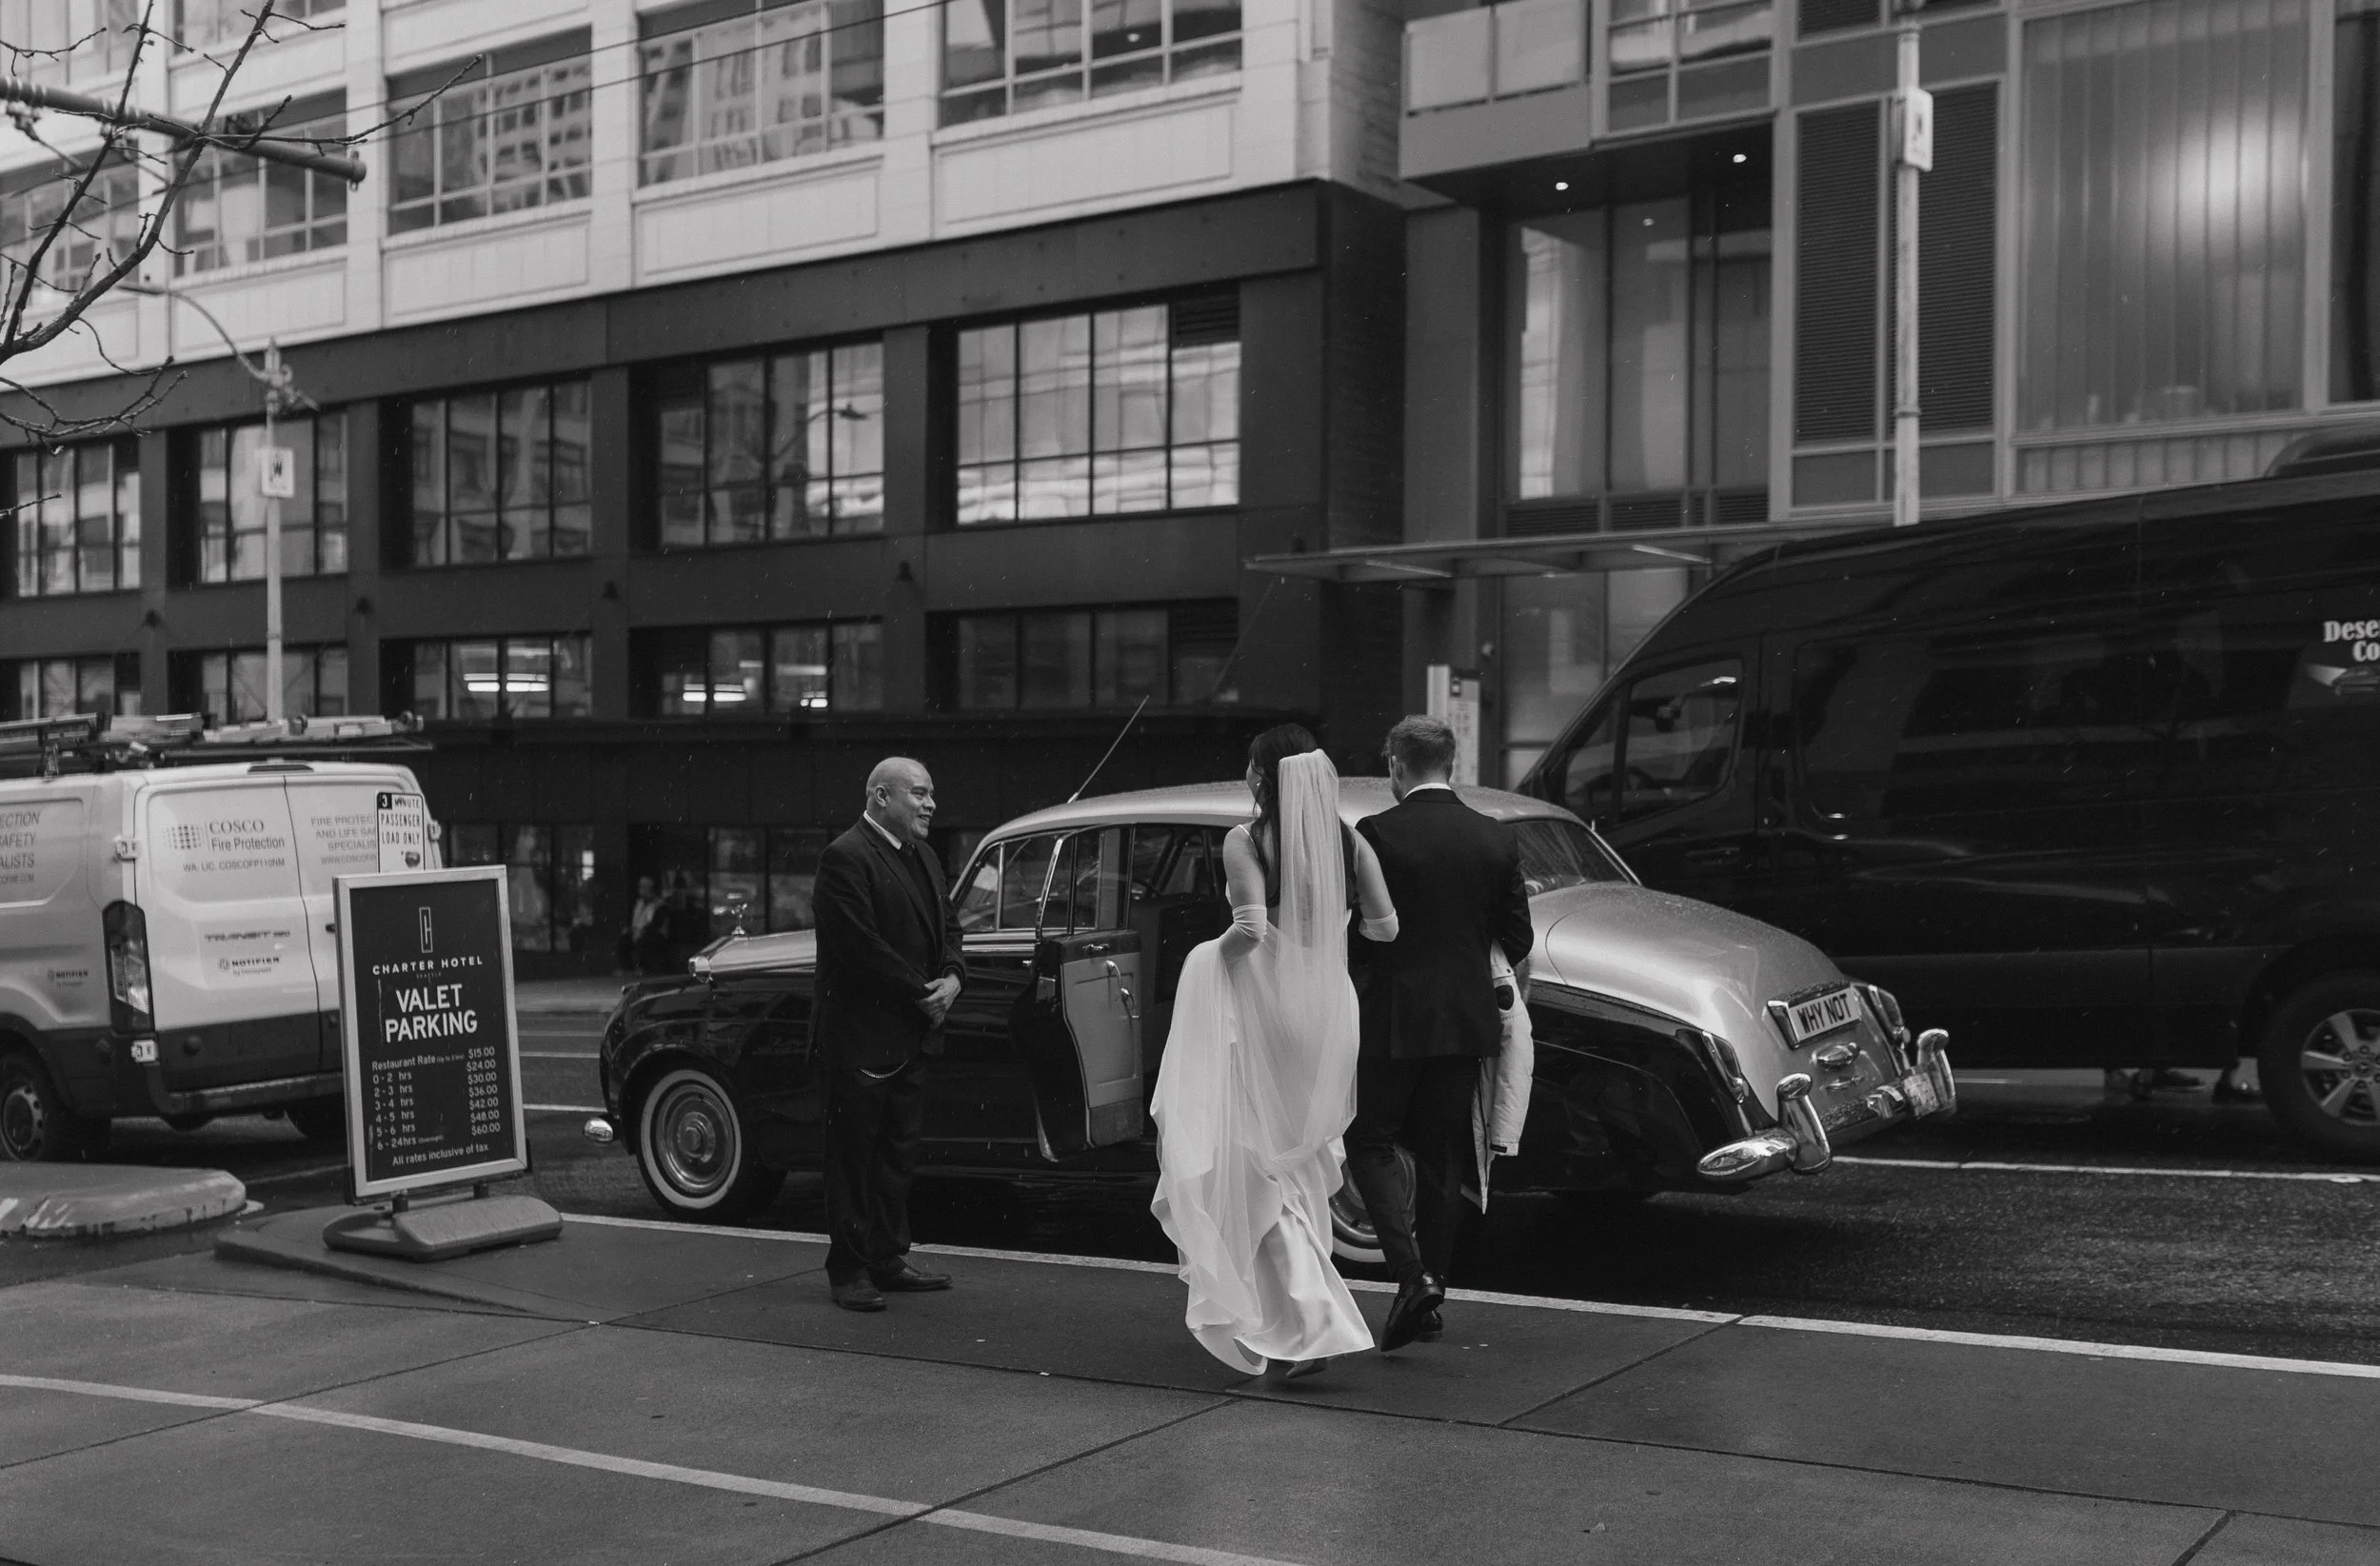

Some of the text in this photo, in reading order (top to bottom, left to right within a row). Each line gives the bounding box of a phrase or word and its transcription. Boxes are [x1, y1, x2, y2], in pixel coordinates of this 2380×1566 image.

[2323, 620, 2380, 643] Dese
[382, 794, 420, 808] 3 MINUTE
[209, 819, 265, 835] COSCO
[310, 814, 376, 827] FIRE PROTEC
[381, 814, 420, 827] PASSENGER
[210, 837, 286, 852] Fire Protection
[316, 828, 336, 840] AND
[338, 827, 359, 839] LIFE
[382, 832, 420, 845] LOAD ONLY
[372, 955, 484, 976] CHARTER HOTEL
[395, 983, 463, 1013] VALET
[385, 1009, 478, 1043] PARKING
[1797, 993, 1851, 1034] WHY NOT
[371, 1056, 416, 1072] Restaurant
[417, 1054, 437, 1066] Rate
[467, 1046, 495, 1060] $15.00
[372, 1074, 379, 1084] 0
[387, 1072, 393, 1082] 2
[398, 1072, 412, 1081] hrs
[466, 1059, 496, 1072] $24.00
[374, 1086, 381, 1098] 2
[387, 1085, 394, 1096] 3
[399, 1085, 413, 1094] hrs
[467, 1071, 497, 1085] $30.00
[374, 1100, 381, 1111] 3
[387, 1099, 395, 1108] 4
[400, 1098, 414, 1107] hrs
[468, 1084, 498, 1098] $36.00
[375, 1114, 382, 1123] 4
[388, 1111, 396, 1122] 5
[401, 1111, 415, 1120] hrs
[469, 1097, 499, 1111] $42.00
[376, 1126, 383, 1138] 5
[389, 1124, 397, 1136] 6
[402, 1123, 416, 1134] hrs
[470, 1109, 500, 1123] $48.00
[377, 1140, 384, 1151] 6
[471, 1122, 501, 1137] $60.00
[392, 1142, 489, 1167] All rates inclusive of tax
